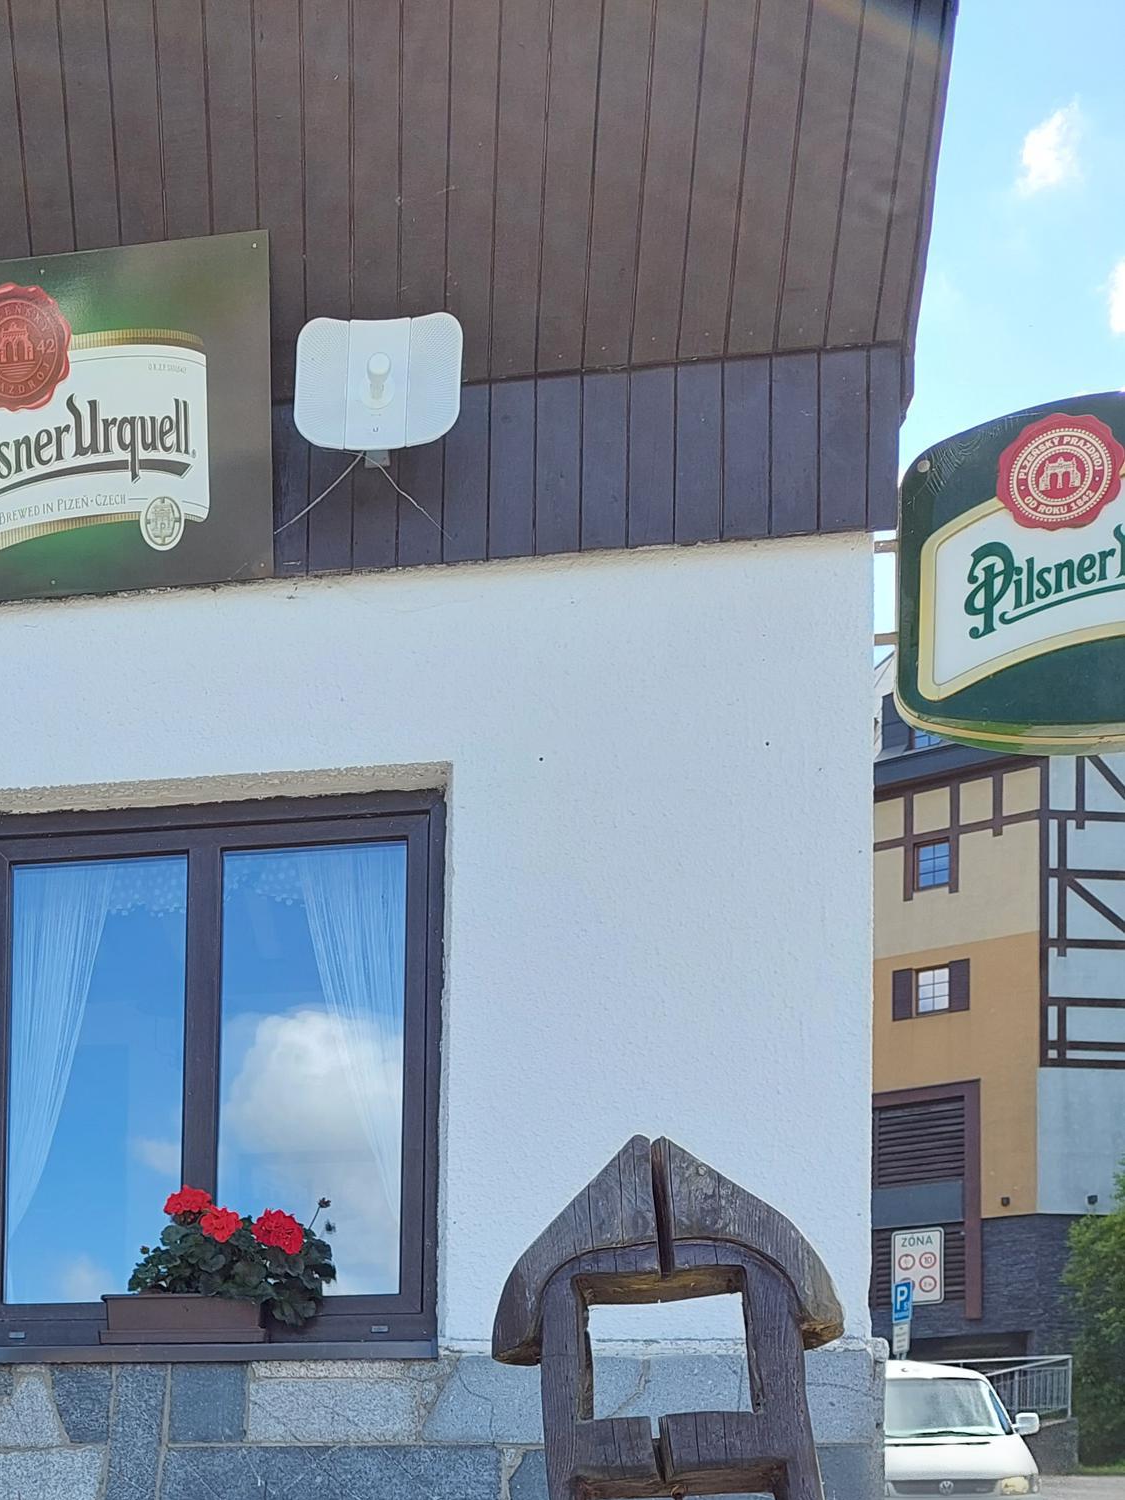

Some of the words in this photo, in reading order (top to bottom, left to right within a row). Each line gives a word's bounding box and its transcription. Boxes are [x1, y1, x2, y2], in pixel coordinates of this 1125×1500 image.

[37, 338, 55, 354] 42
[1063, 436, 1104, 471] PRAZDROJ
[42, 502, 54, 515] IN
[1024, 496, 1038, 509] OD
[1037, 505, 1068, 515] ROKU
[1070, 490, 1095, 511] 1842
[964, 541, 1117, 640] Pilsner
[901, 1235, 933, 1248] ZONA
[896, 1286, 908, 1311] P
